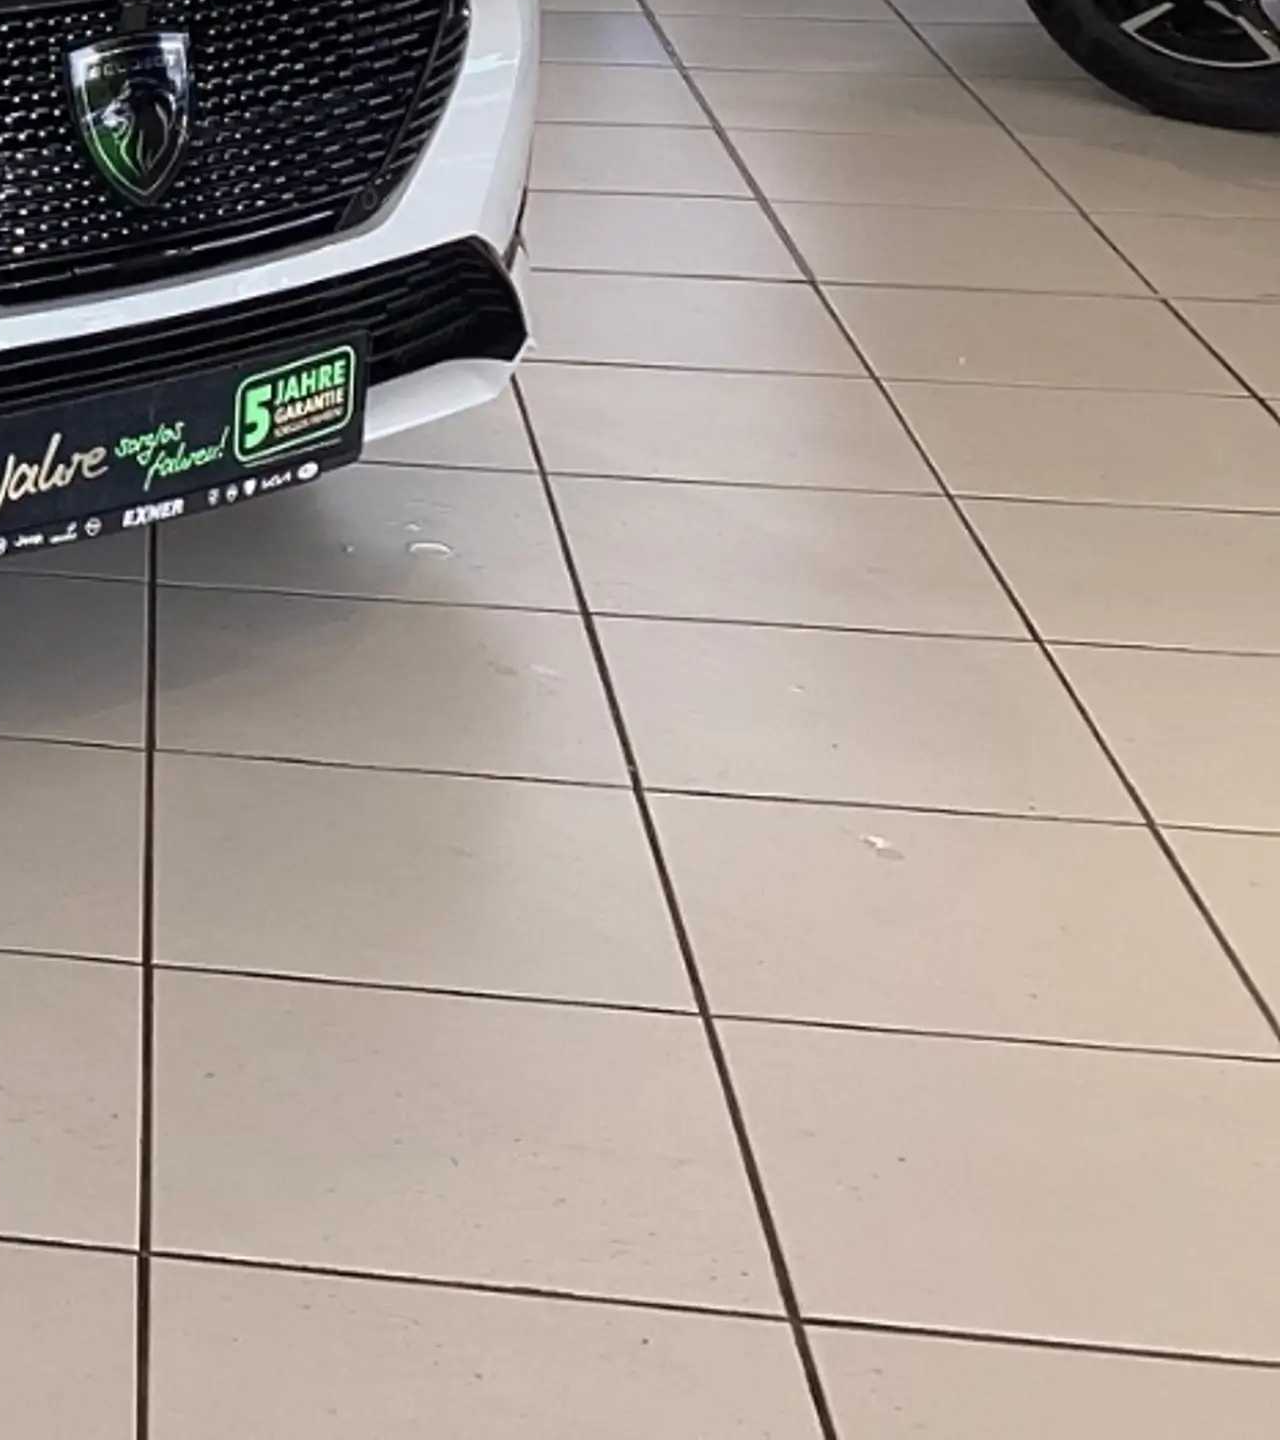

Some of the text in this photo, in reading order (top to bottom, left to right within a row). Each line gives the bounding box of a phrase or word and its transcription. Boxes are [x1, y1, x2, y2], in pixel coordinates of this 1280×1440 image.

[274, 359, 347, 405] JAHRE
[244, 383, 272, 449] 5
[274, 386, 345, 424] GARANTIE
[121, 498, 185, 528] EXNER
